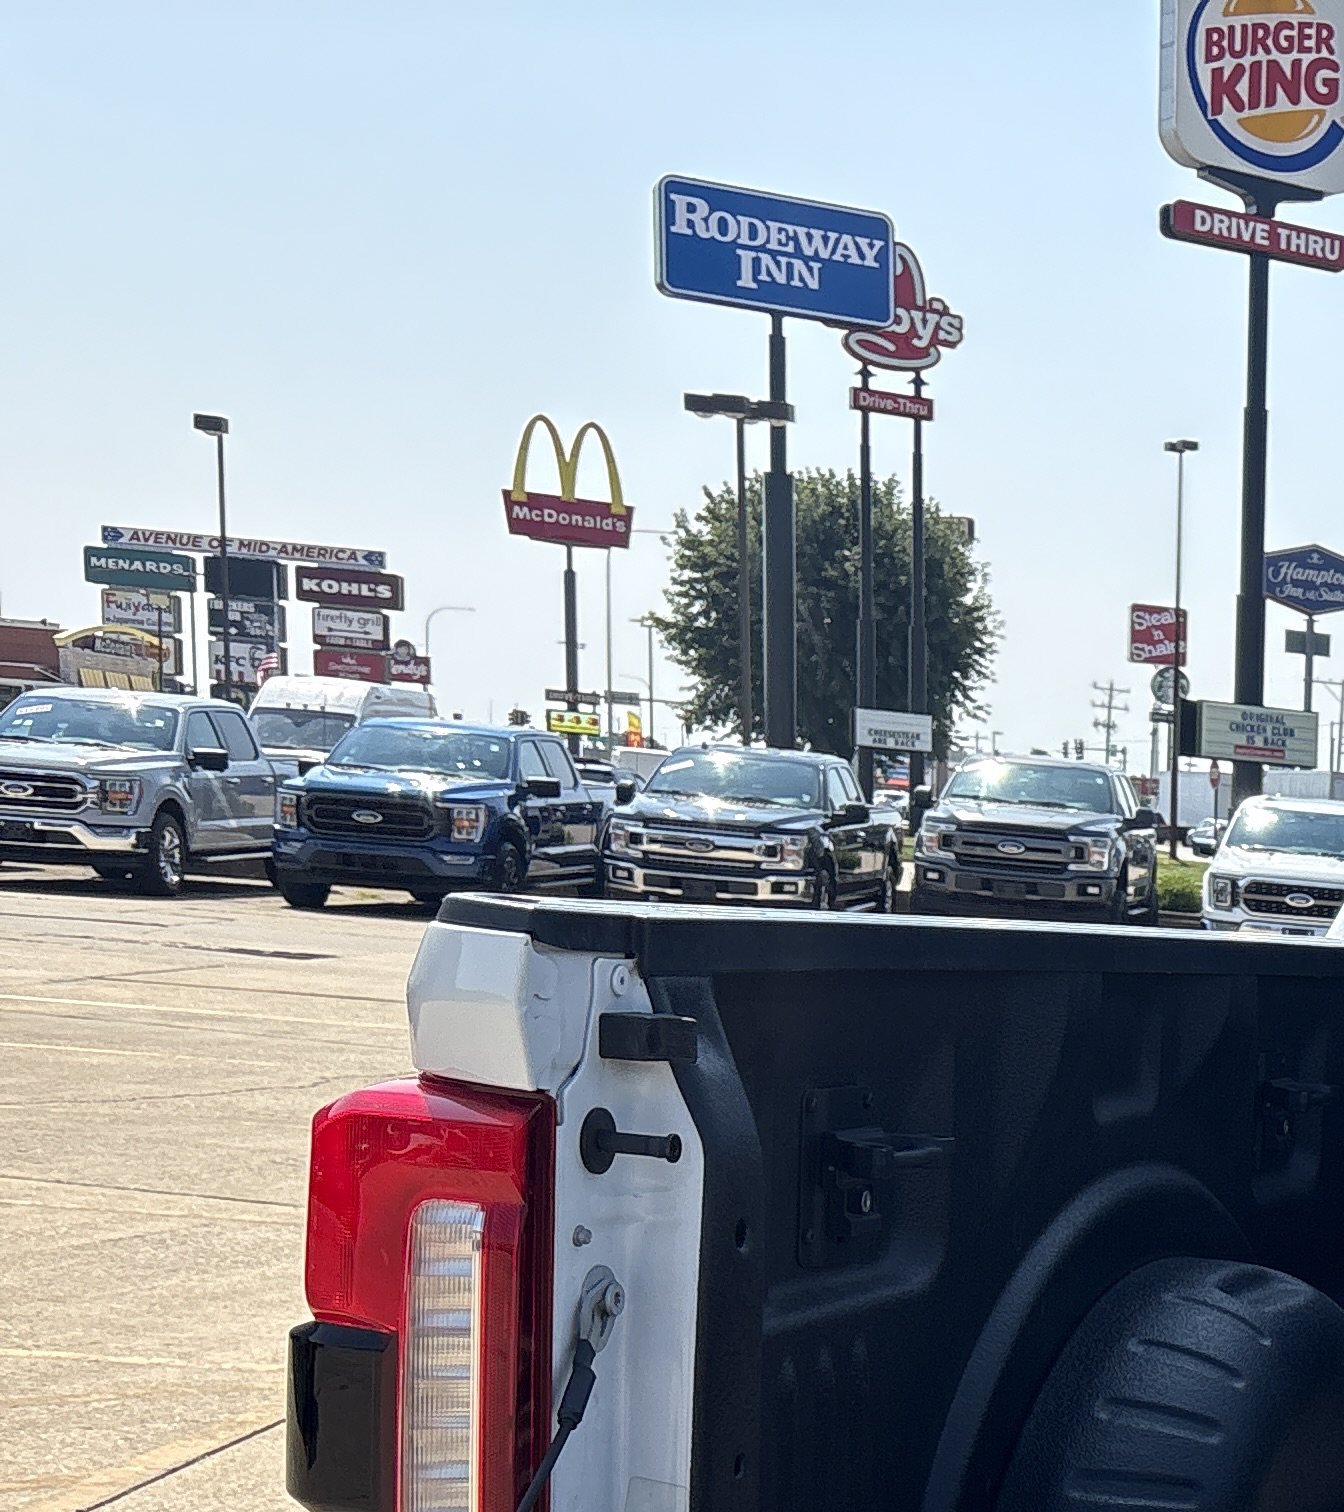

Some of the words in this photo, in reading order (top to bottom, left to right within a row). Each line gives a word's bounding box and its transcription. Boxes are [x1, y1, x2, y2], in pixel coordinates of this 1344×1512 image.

[1204, 20, 1336, 64] BURGER
[1210, 57, 1340, 117] KING
[669, 192, 886, 269] RODEWAY
[1193, 208, 1270, 246] DRIVE
[1277, 227, 1341, 261] THRU
[736, 248, 822, 290] INN
[859, 391, 929, 416] Drive-Thru
[511, 505, 627, 533] McDonald's
[128, 530, 203, 549] AVENUE
[238, 539, 360, 563] MID-AMERICA
[90, 556, 185, 576] MENARDS
[301, 577, 393, 599] KOHL'S
[1275, 583, 1306, 600] Inn
[316, 610, 355, 628] firefly
[391, 659, 428, 680] endy's
